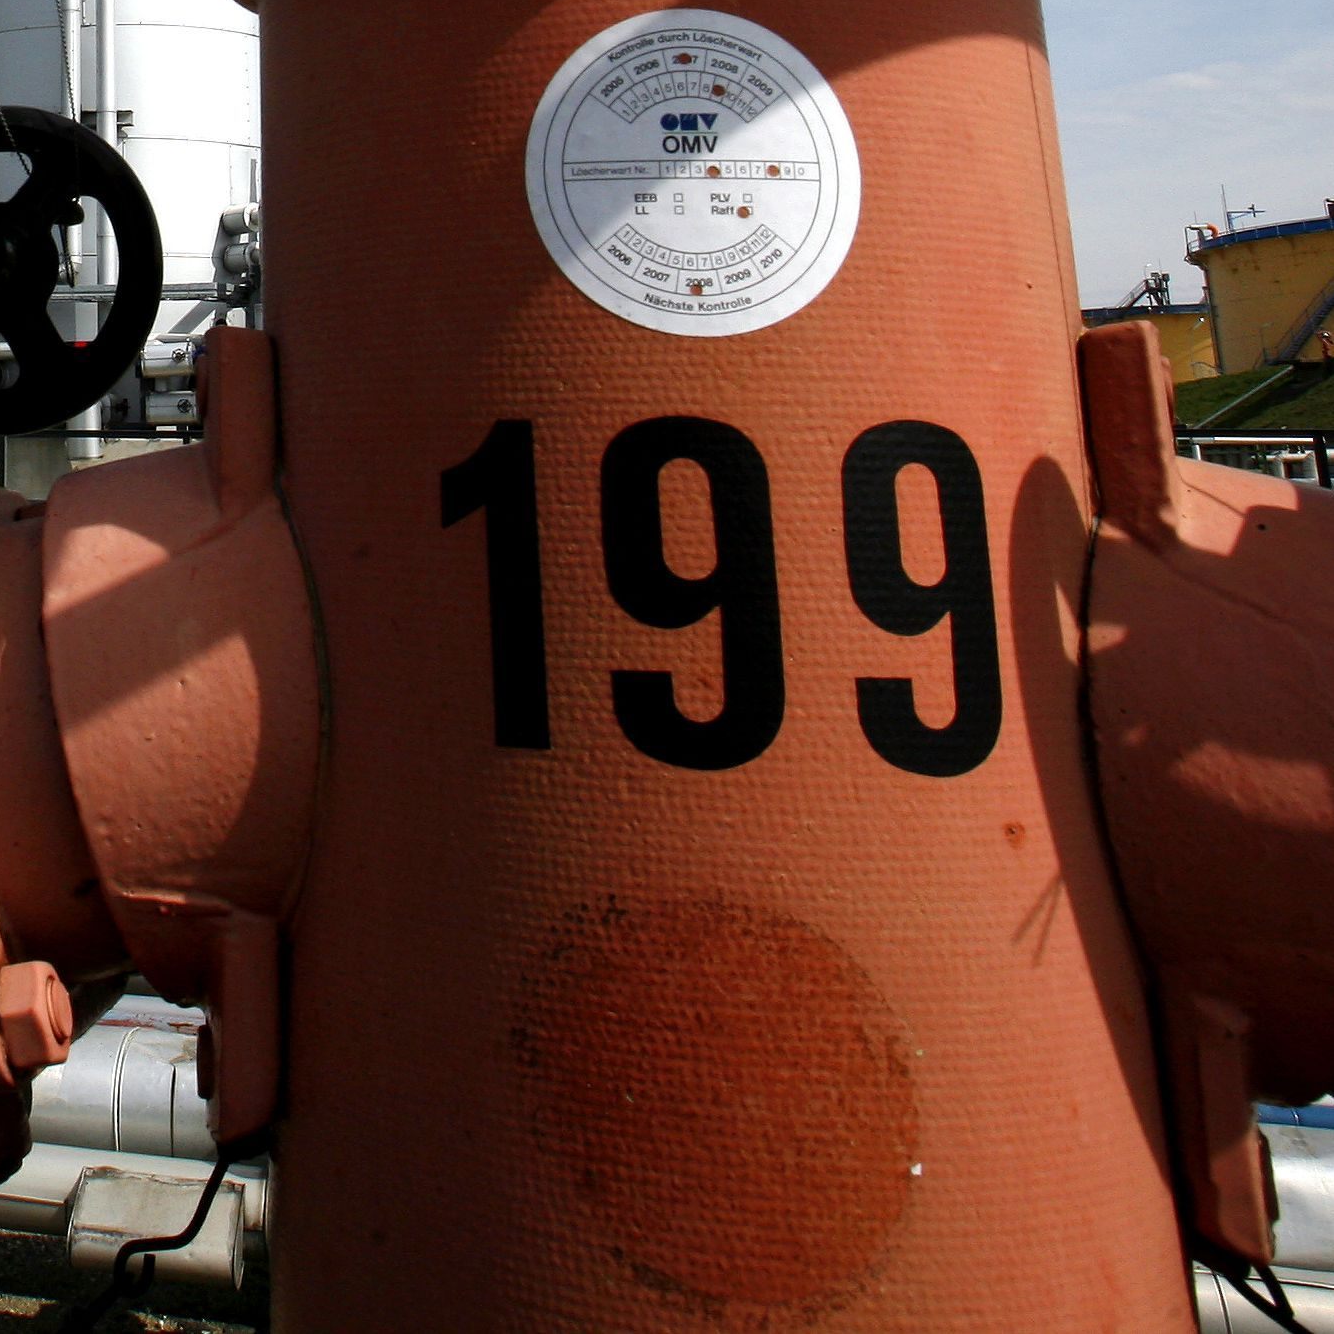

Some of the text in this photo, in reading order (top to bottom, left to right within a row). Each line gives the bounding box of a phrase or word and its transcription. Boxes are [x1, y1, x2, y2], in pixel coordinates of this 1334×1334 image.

[608, 32, 763, 63] Kontrolle durch Löscherwart
[633, 59, 660, 75] 2006
[672, 53, 699, 65] 27
[711, 58, 739, 74] 2008
[747, 74, 773, 96] 2009
[630, 100, 639, 109] 2
[640, 93, 649, 103] 3
[653, 87, 660, 96] 4
[665, 83, 672, 93] 5
[677, 82, 684, 91] 6
[690, 82, 697, 91] 7
[703, 83, 710, 93] 8
[662, 135, 718, 154] OMV
[571, 167, 632, 177] Löscherwart
[680, 166, 686, 174] 2
[695, 166, 702, 174] 3
[725, 166, 732, 174] 5
[739, 166, 746, 174] 6
[755, 166, 761, 174] 7
[797, 167, 805, 175] 0
[635, 206, 734, 215] LL Raff
[710, 193, 731, 203] PLV
[623, 229, 771, 267] 1 2 3 4 5 6 7 8 9 10 11 12
[607, 244, 783, 288] 2006 2007 2008 2009 2010
[644, 292, 752, 312] Nächste Kontrolle
[440, 415, 1003, 778] 199
